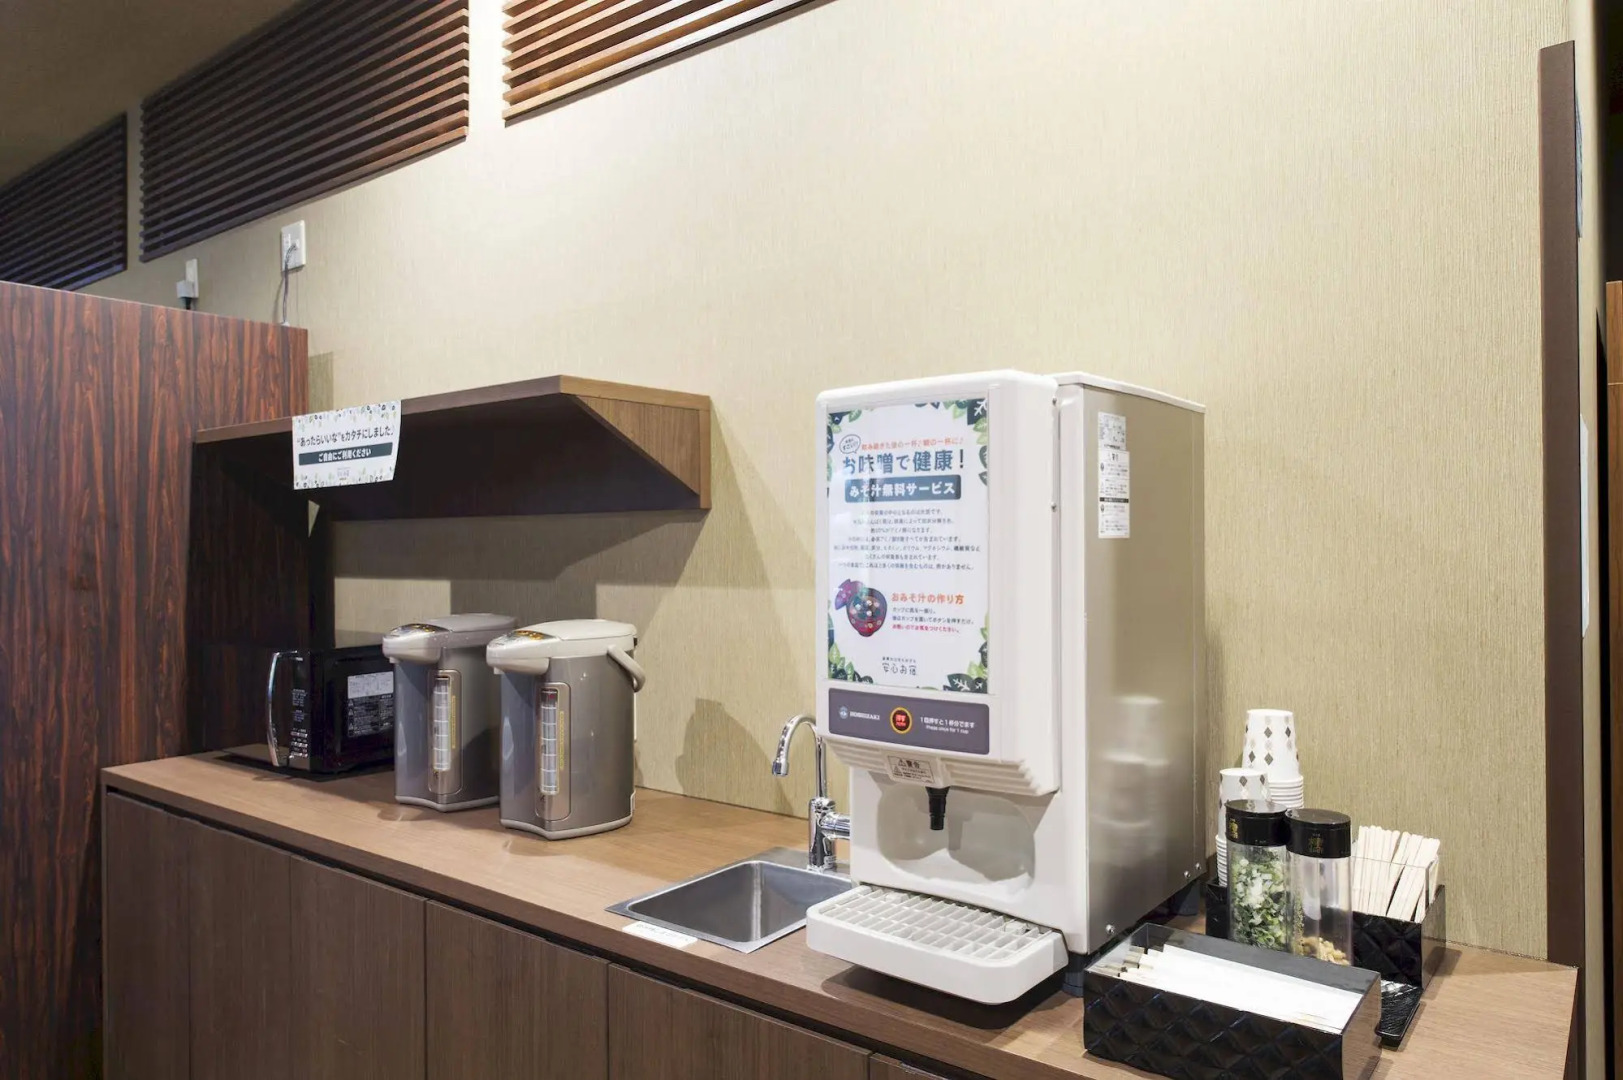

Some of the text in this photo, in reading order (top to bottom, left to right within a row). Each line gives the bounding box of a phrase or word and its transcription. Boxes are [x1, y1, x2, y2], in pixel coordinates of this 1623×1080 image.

[318, 447, 372, 463] ご自由にご利用ください
[849, 481, 956, 498] みそ汁無料サービス
[891, 593, 965, 605] おみそ汁の作り方
